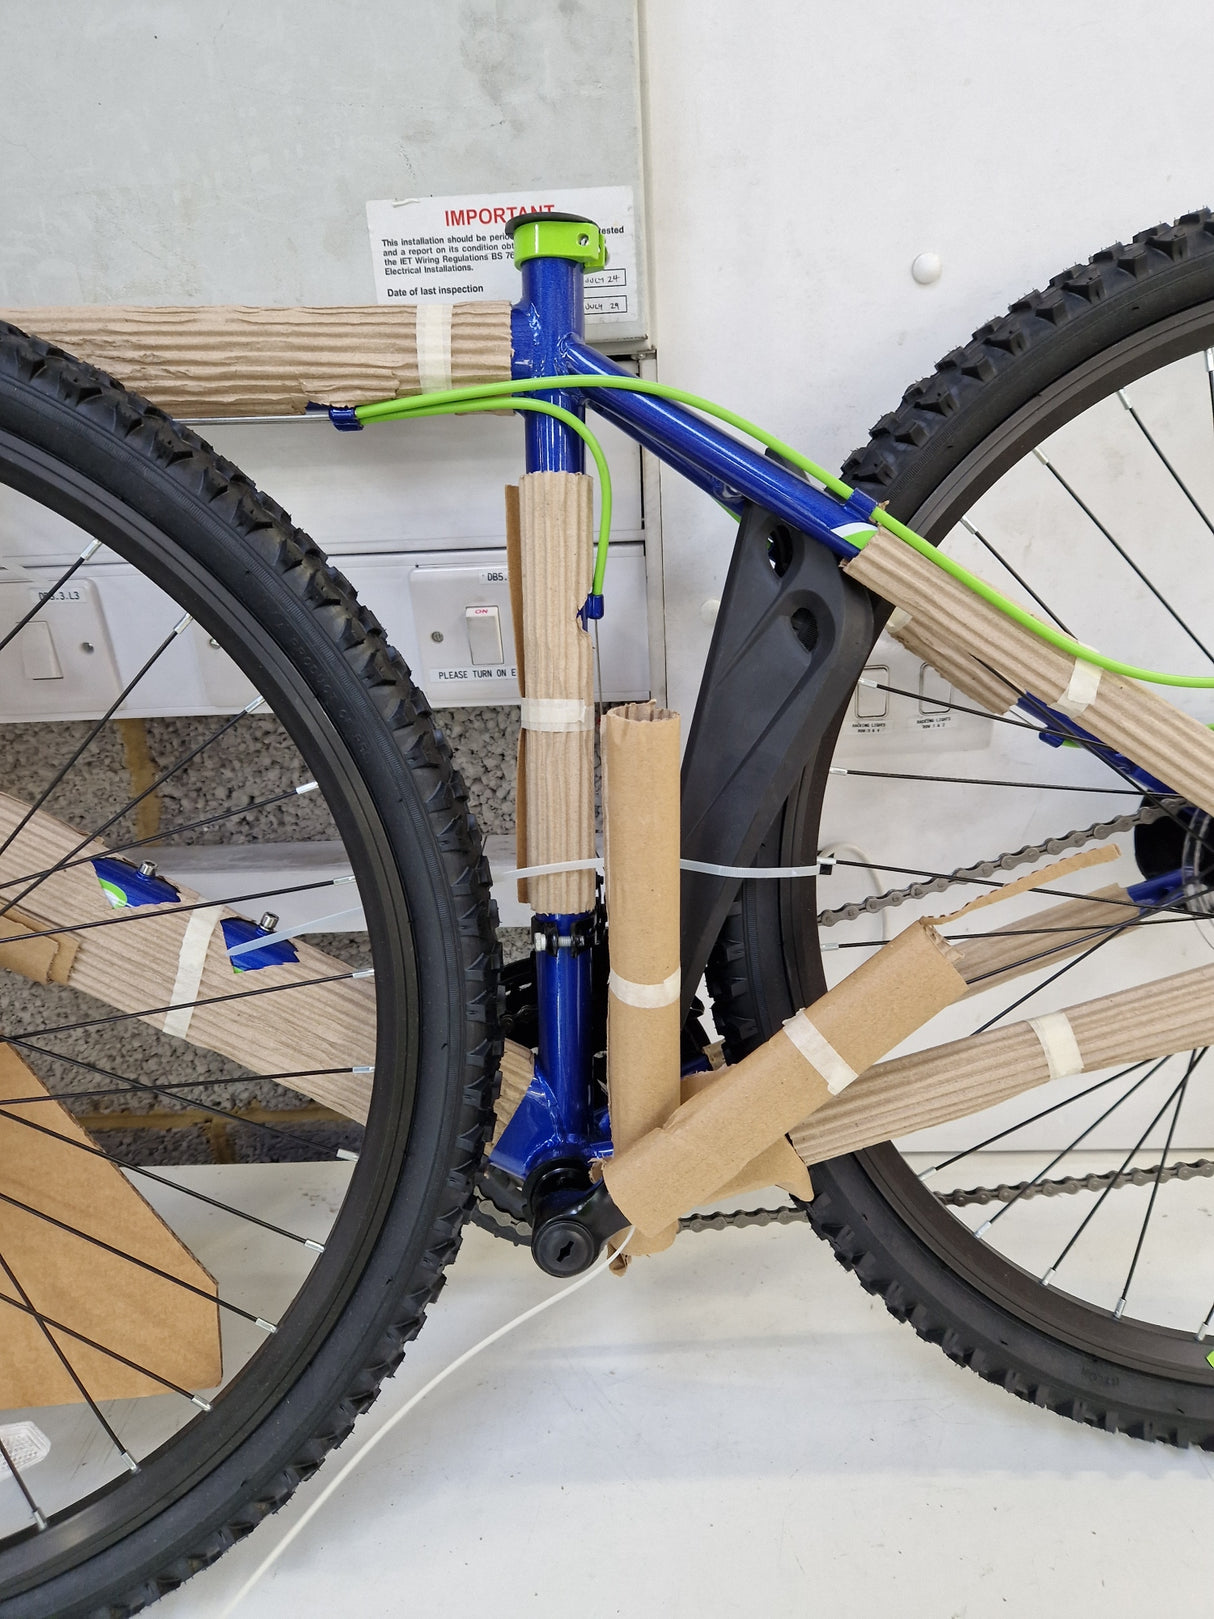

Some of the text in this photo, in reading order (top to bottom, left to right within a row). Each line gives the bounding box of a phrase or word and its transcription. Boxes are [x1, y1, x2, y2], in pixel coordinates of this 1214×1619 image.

[382, 239, 398, 248] This
[400, 238, 444, 246] installation
[448, 234, 474, 244] should
[476, 234, 486, 242] be
[600, 226, 624, 234] ested
[383, 249, 398, 257] and
[408, 246, 433, 256] report
[448, 245, 459, 254] its
[462, 242, 499, 252] condition
[384, 258, 397, 266] the
[400, 257, 412, 265] IET
[415, 256, 440, 265] Wiring
[442, 252, 489, 264] Regulations
[492, 252, 503, 260] BS
[384, 263, 474, 276] Electrical Installations.
[607, 274, 620, 283] 24
[387, 284, 484, 297] Date of last inspection
[439, 671, 468, 680] PLEASE
[473, 669, 492, 678] TURN
[496, 669, 506, 677] ON
